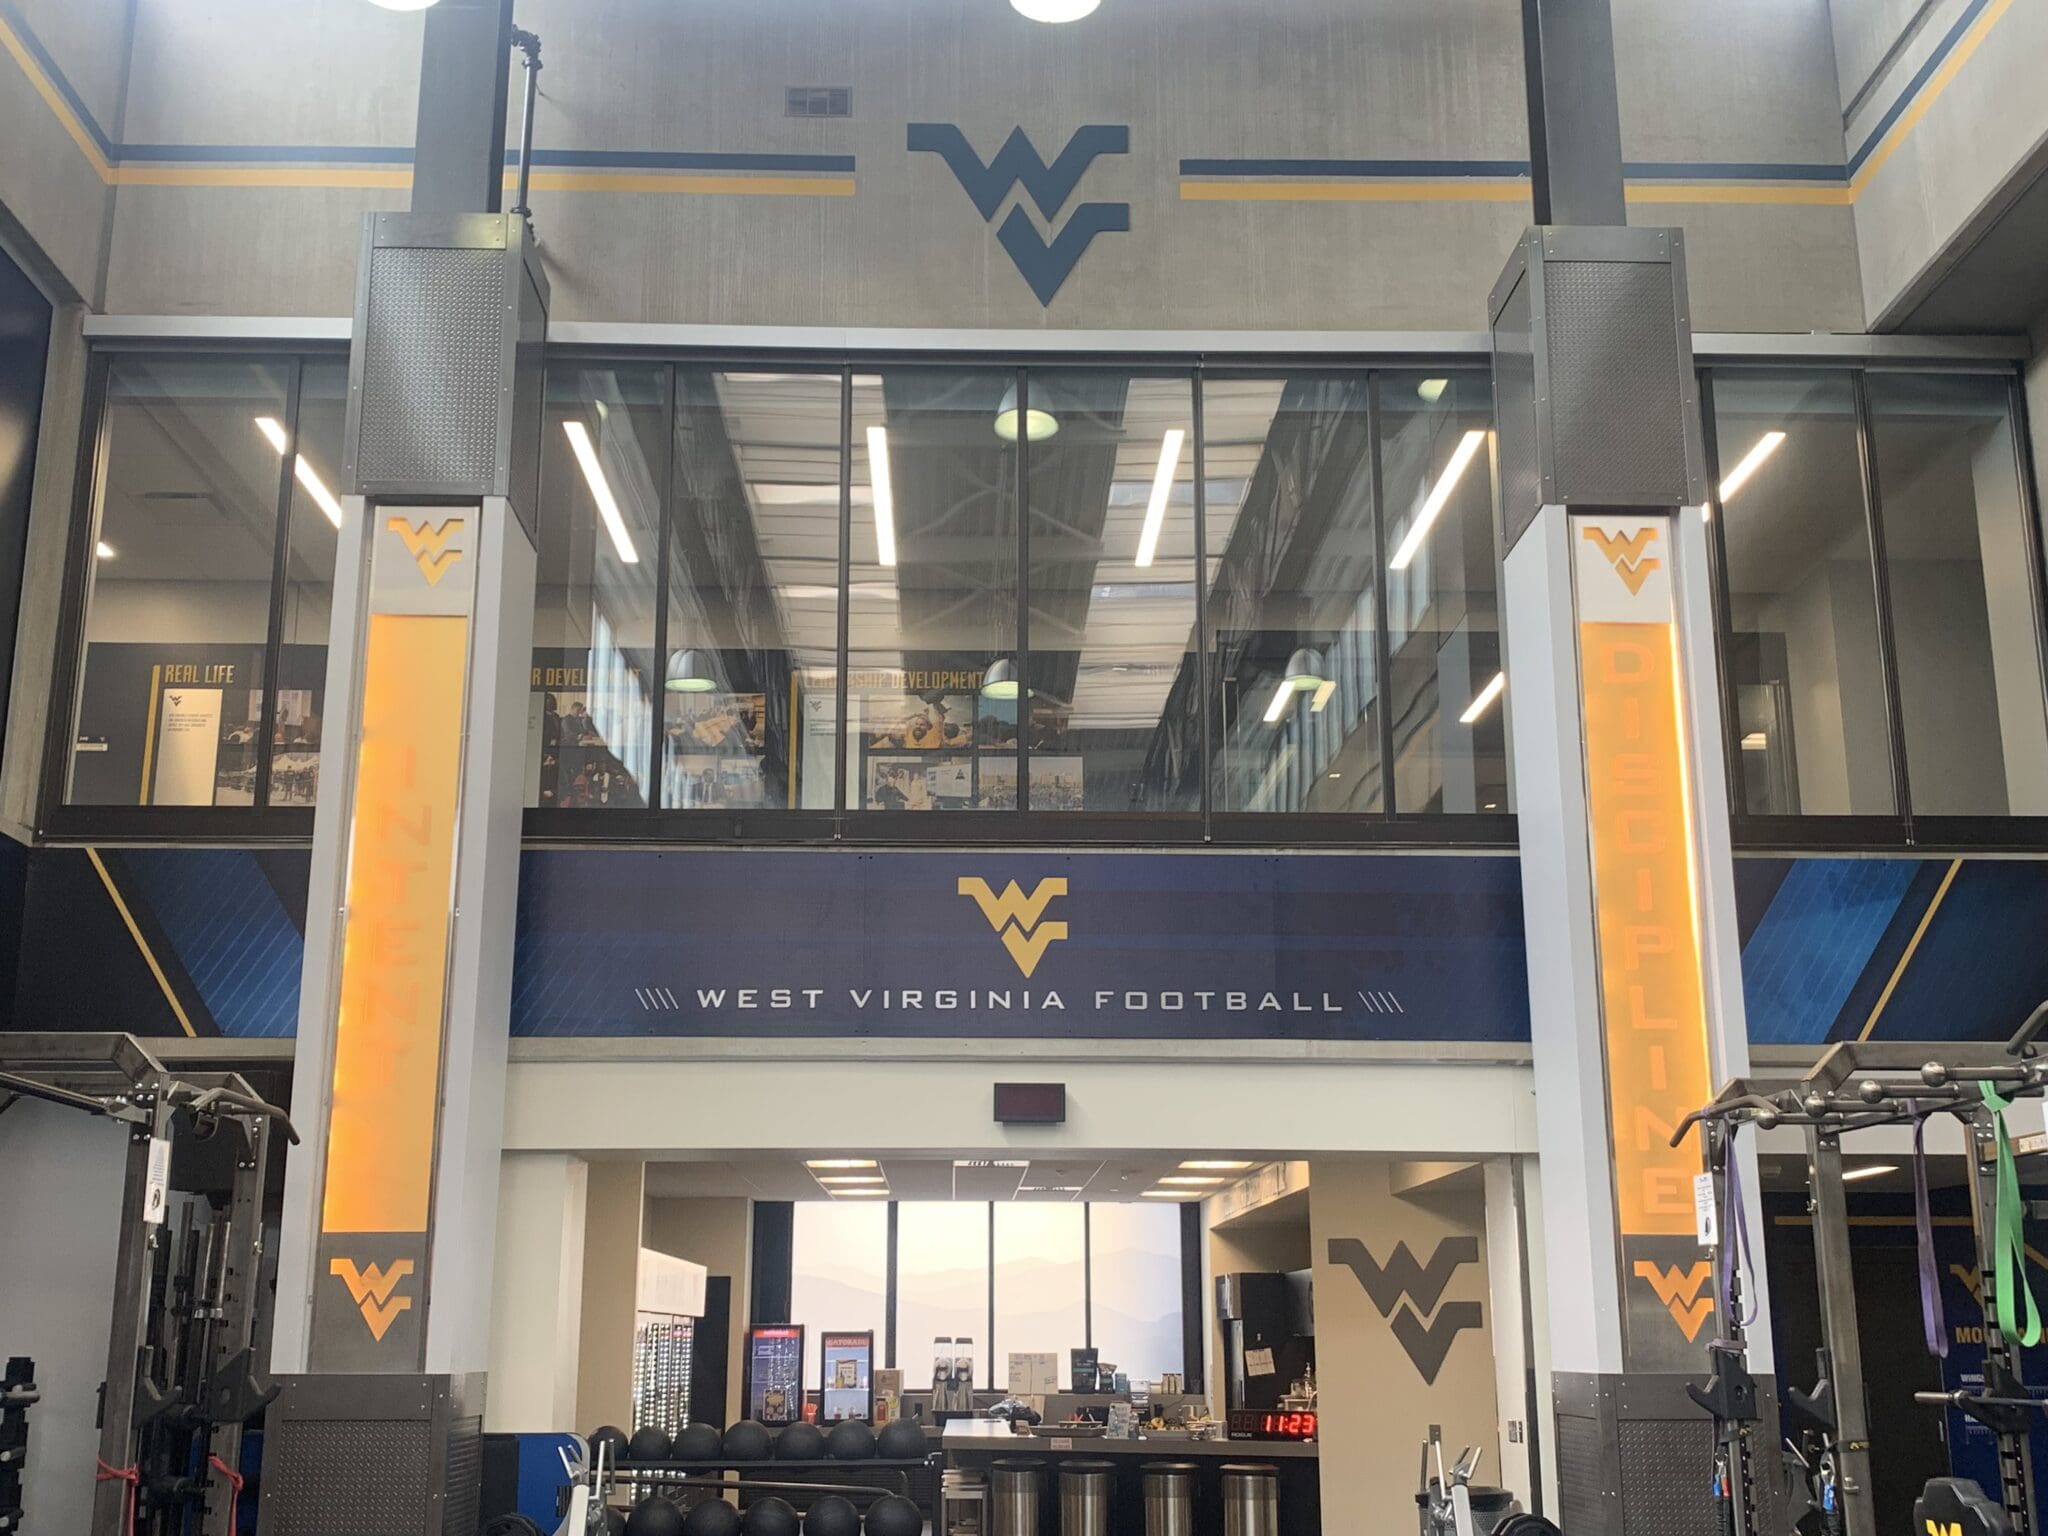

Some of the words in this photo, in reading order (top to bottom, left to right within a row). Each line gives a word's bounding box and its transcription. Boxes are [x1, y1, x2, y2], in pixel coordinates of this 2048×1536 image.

[165, 664, 200, 683] REAL
[204, 664, 235, 683] LIFE
[891, 671, 985, 689] DEVELOPMENT
[1600, 641, 1697, 1215] DISCIPLINE
[696, 989, 824, 1009] WEST
[849, 989, 1066, 1010] VIRGINIA
[1095, 990, 1344, 1012] FOOTBALL
[1265, 1413, 1316, 1433] 11:23
